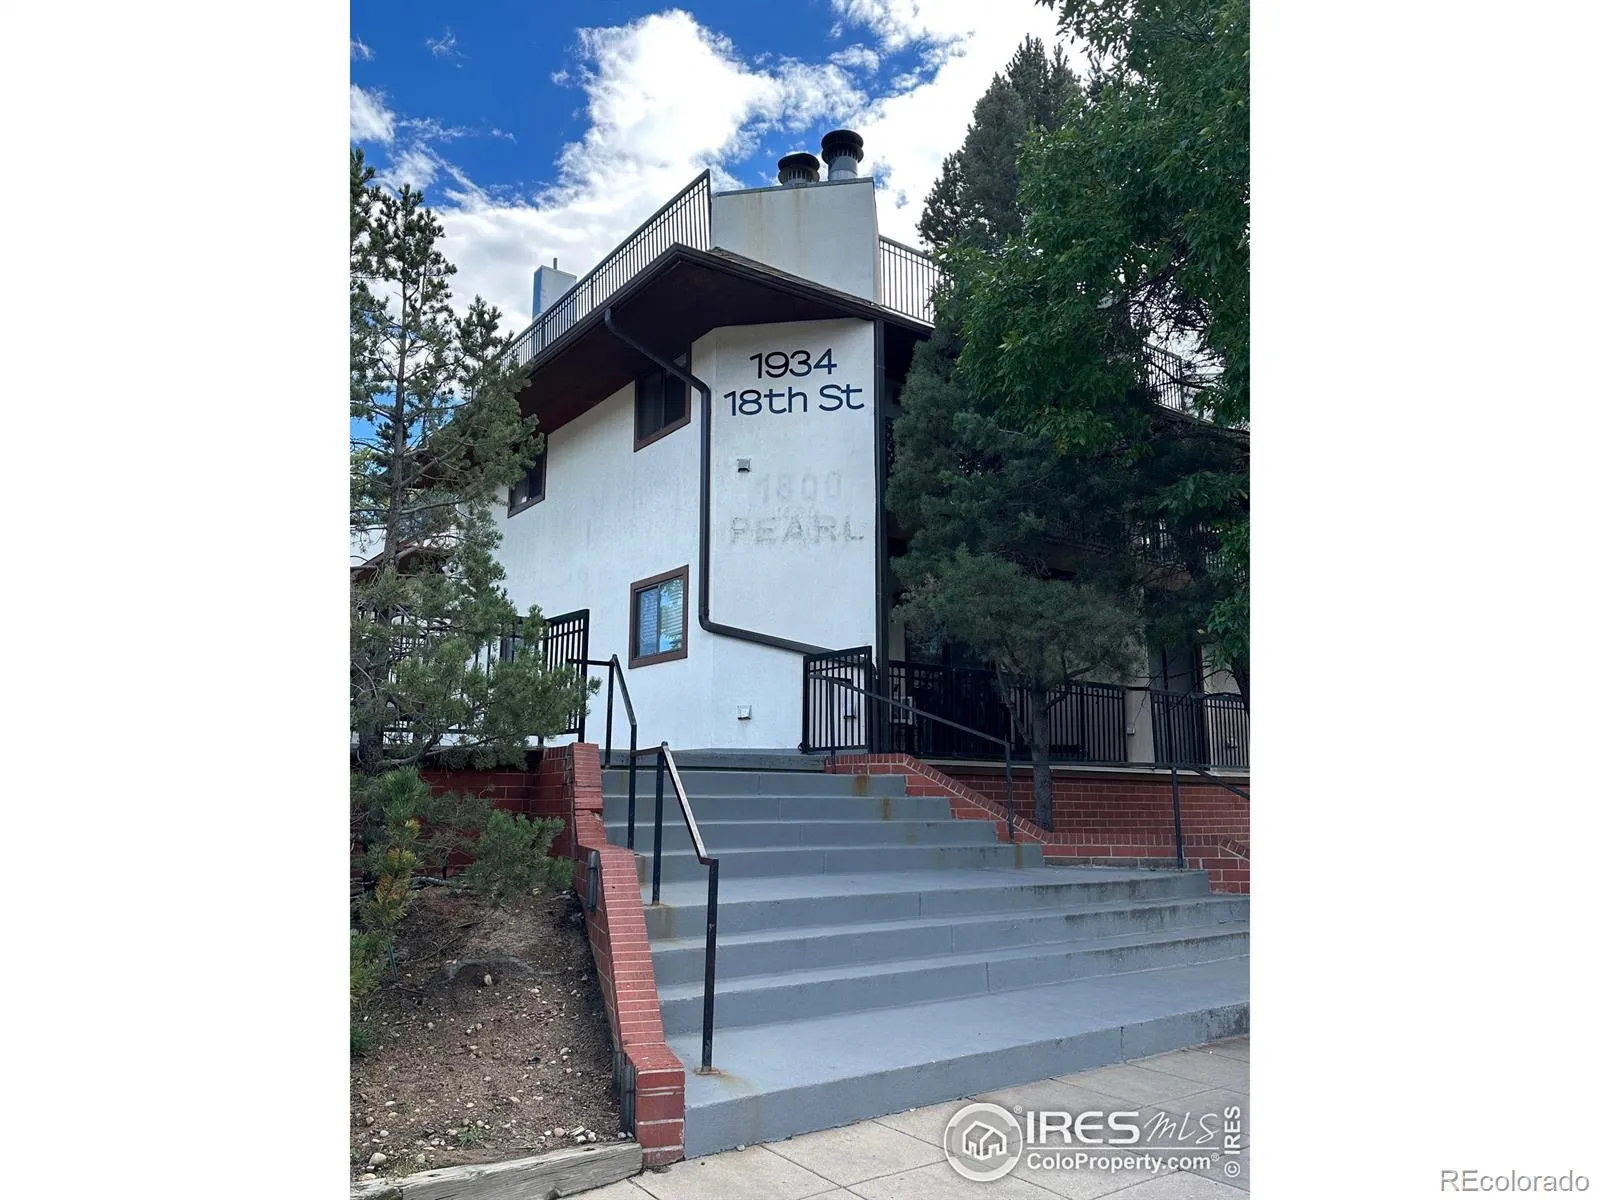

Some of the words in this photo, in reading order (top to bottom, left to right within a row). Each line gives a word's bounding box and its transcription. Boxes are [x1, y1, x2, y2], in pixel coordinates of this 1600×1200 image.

[750, 348, 837, 378] 1934
[723, 386, 808, 416] 18th
[818, 384, 865, 411] St
[757, 471, 842, 502] 1800
[730, 515, 864, 544] PEARL
